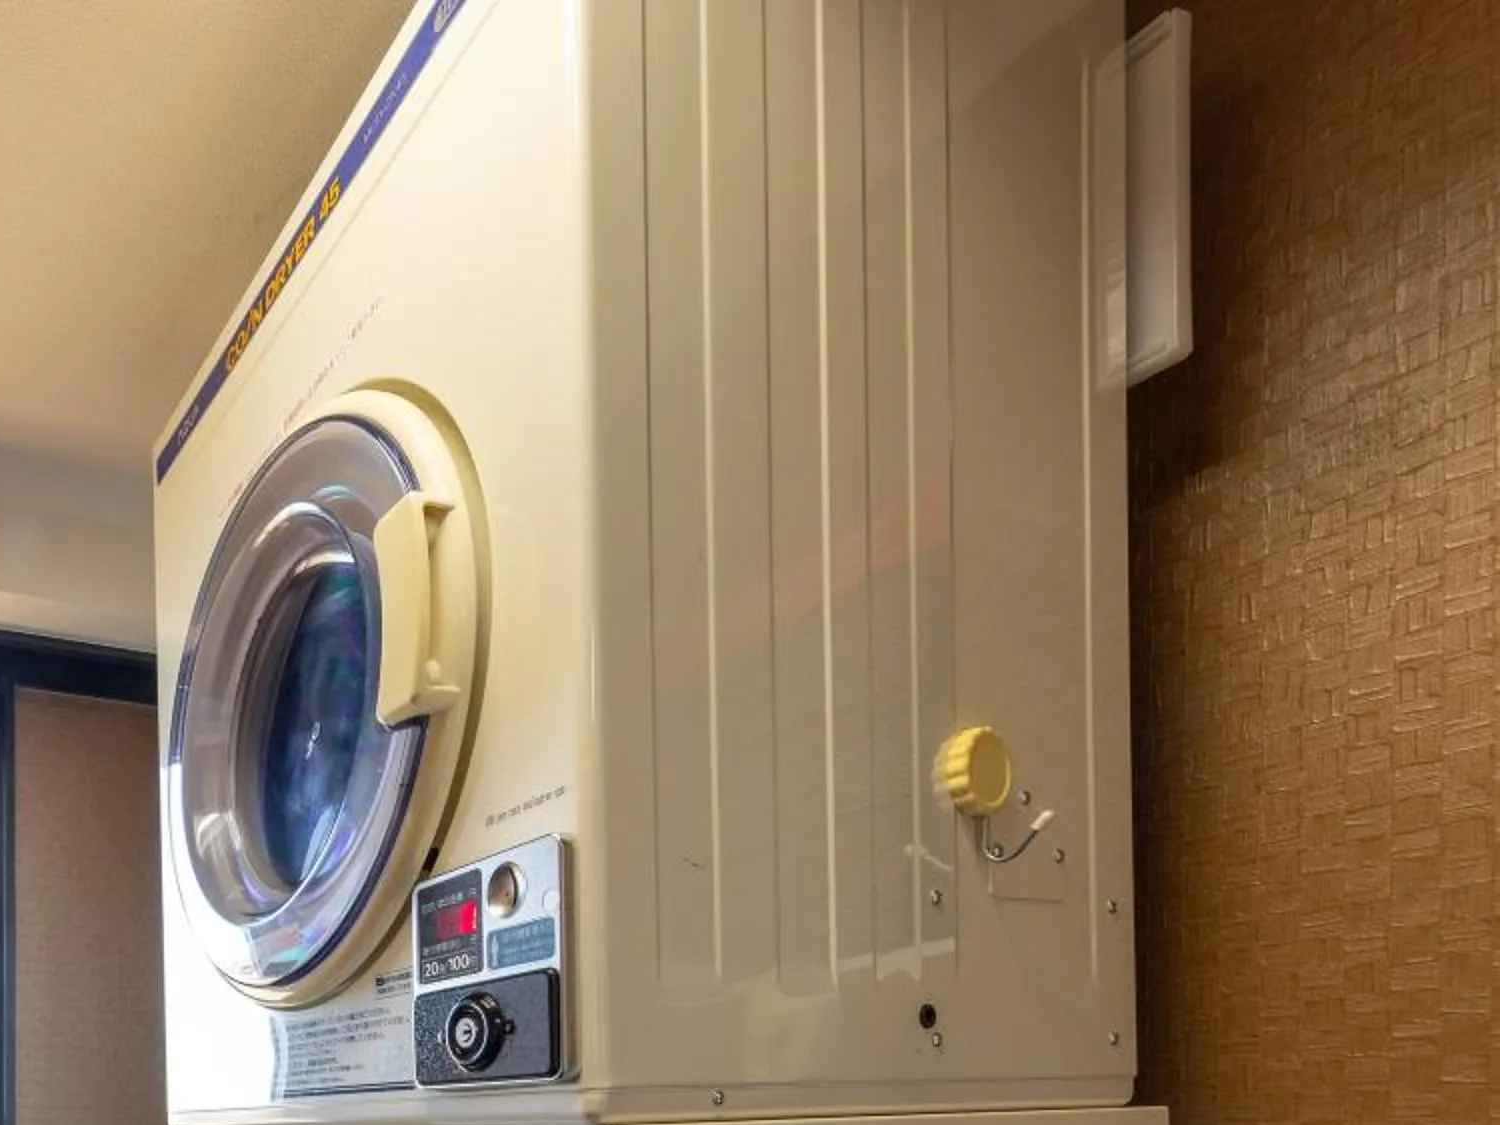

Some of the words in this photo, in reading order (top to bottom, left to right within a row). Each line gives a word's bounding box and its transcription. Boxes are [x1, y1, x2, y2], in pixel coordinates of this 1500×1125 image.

[226, 299, 264, 373] COIN
[265, 214, 316, 309] DRYER
[319, 176, 341, 221] 45
